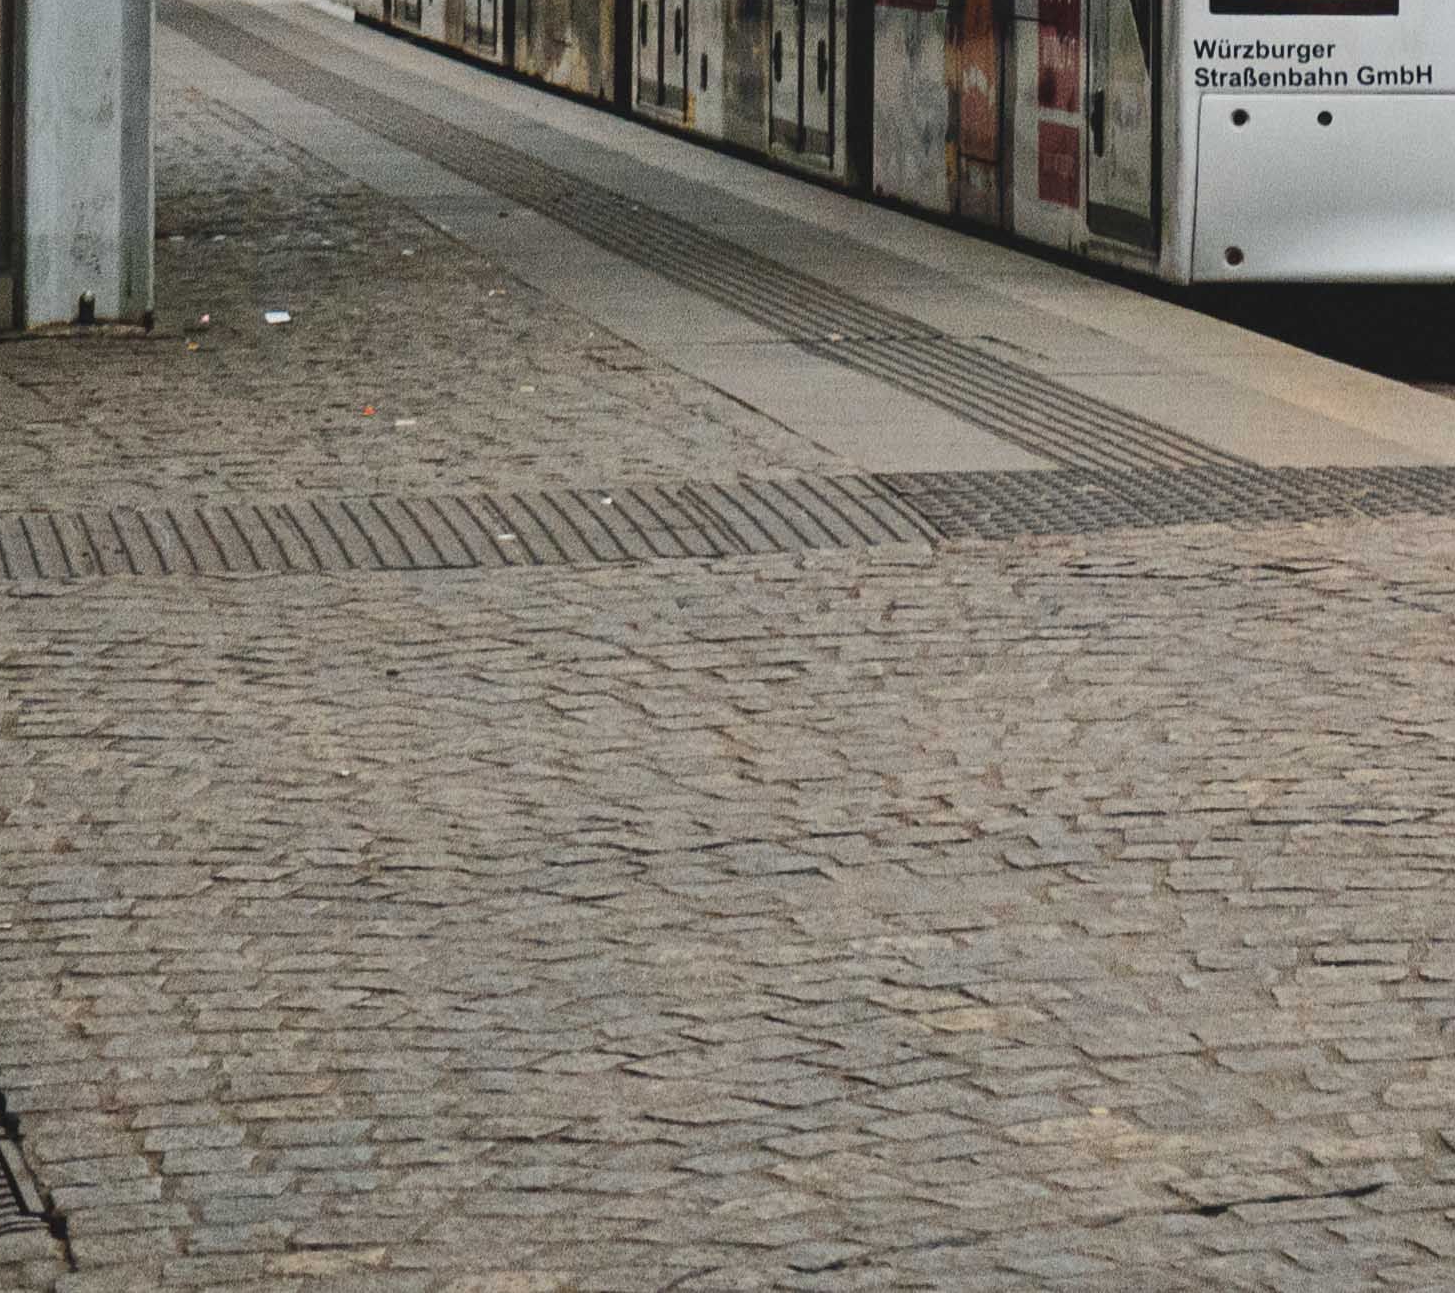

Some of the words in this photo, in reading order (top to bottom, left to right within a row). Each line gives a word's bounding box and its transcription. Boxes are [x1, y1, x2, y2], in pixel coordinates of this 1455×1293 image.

[1194, 39, 1336, 63] Würzburger
[1194, 66, 1349, 87] Straßenbahn
[1357, 64, 1433, 86] GmbH
